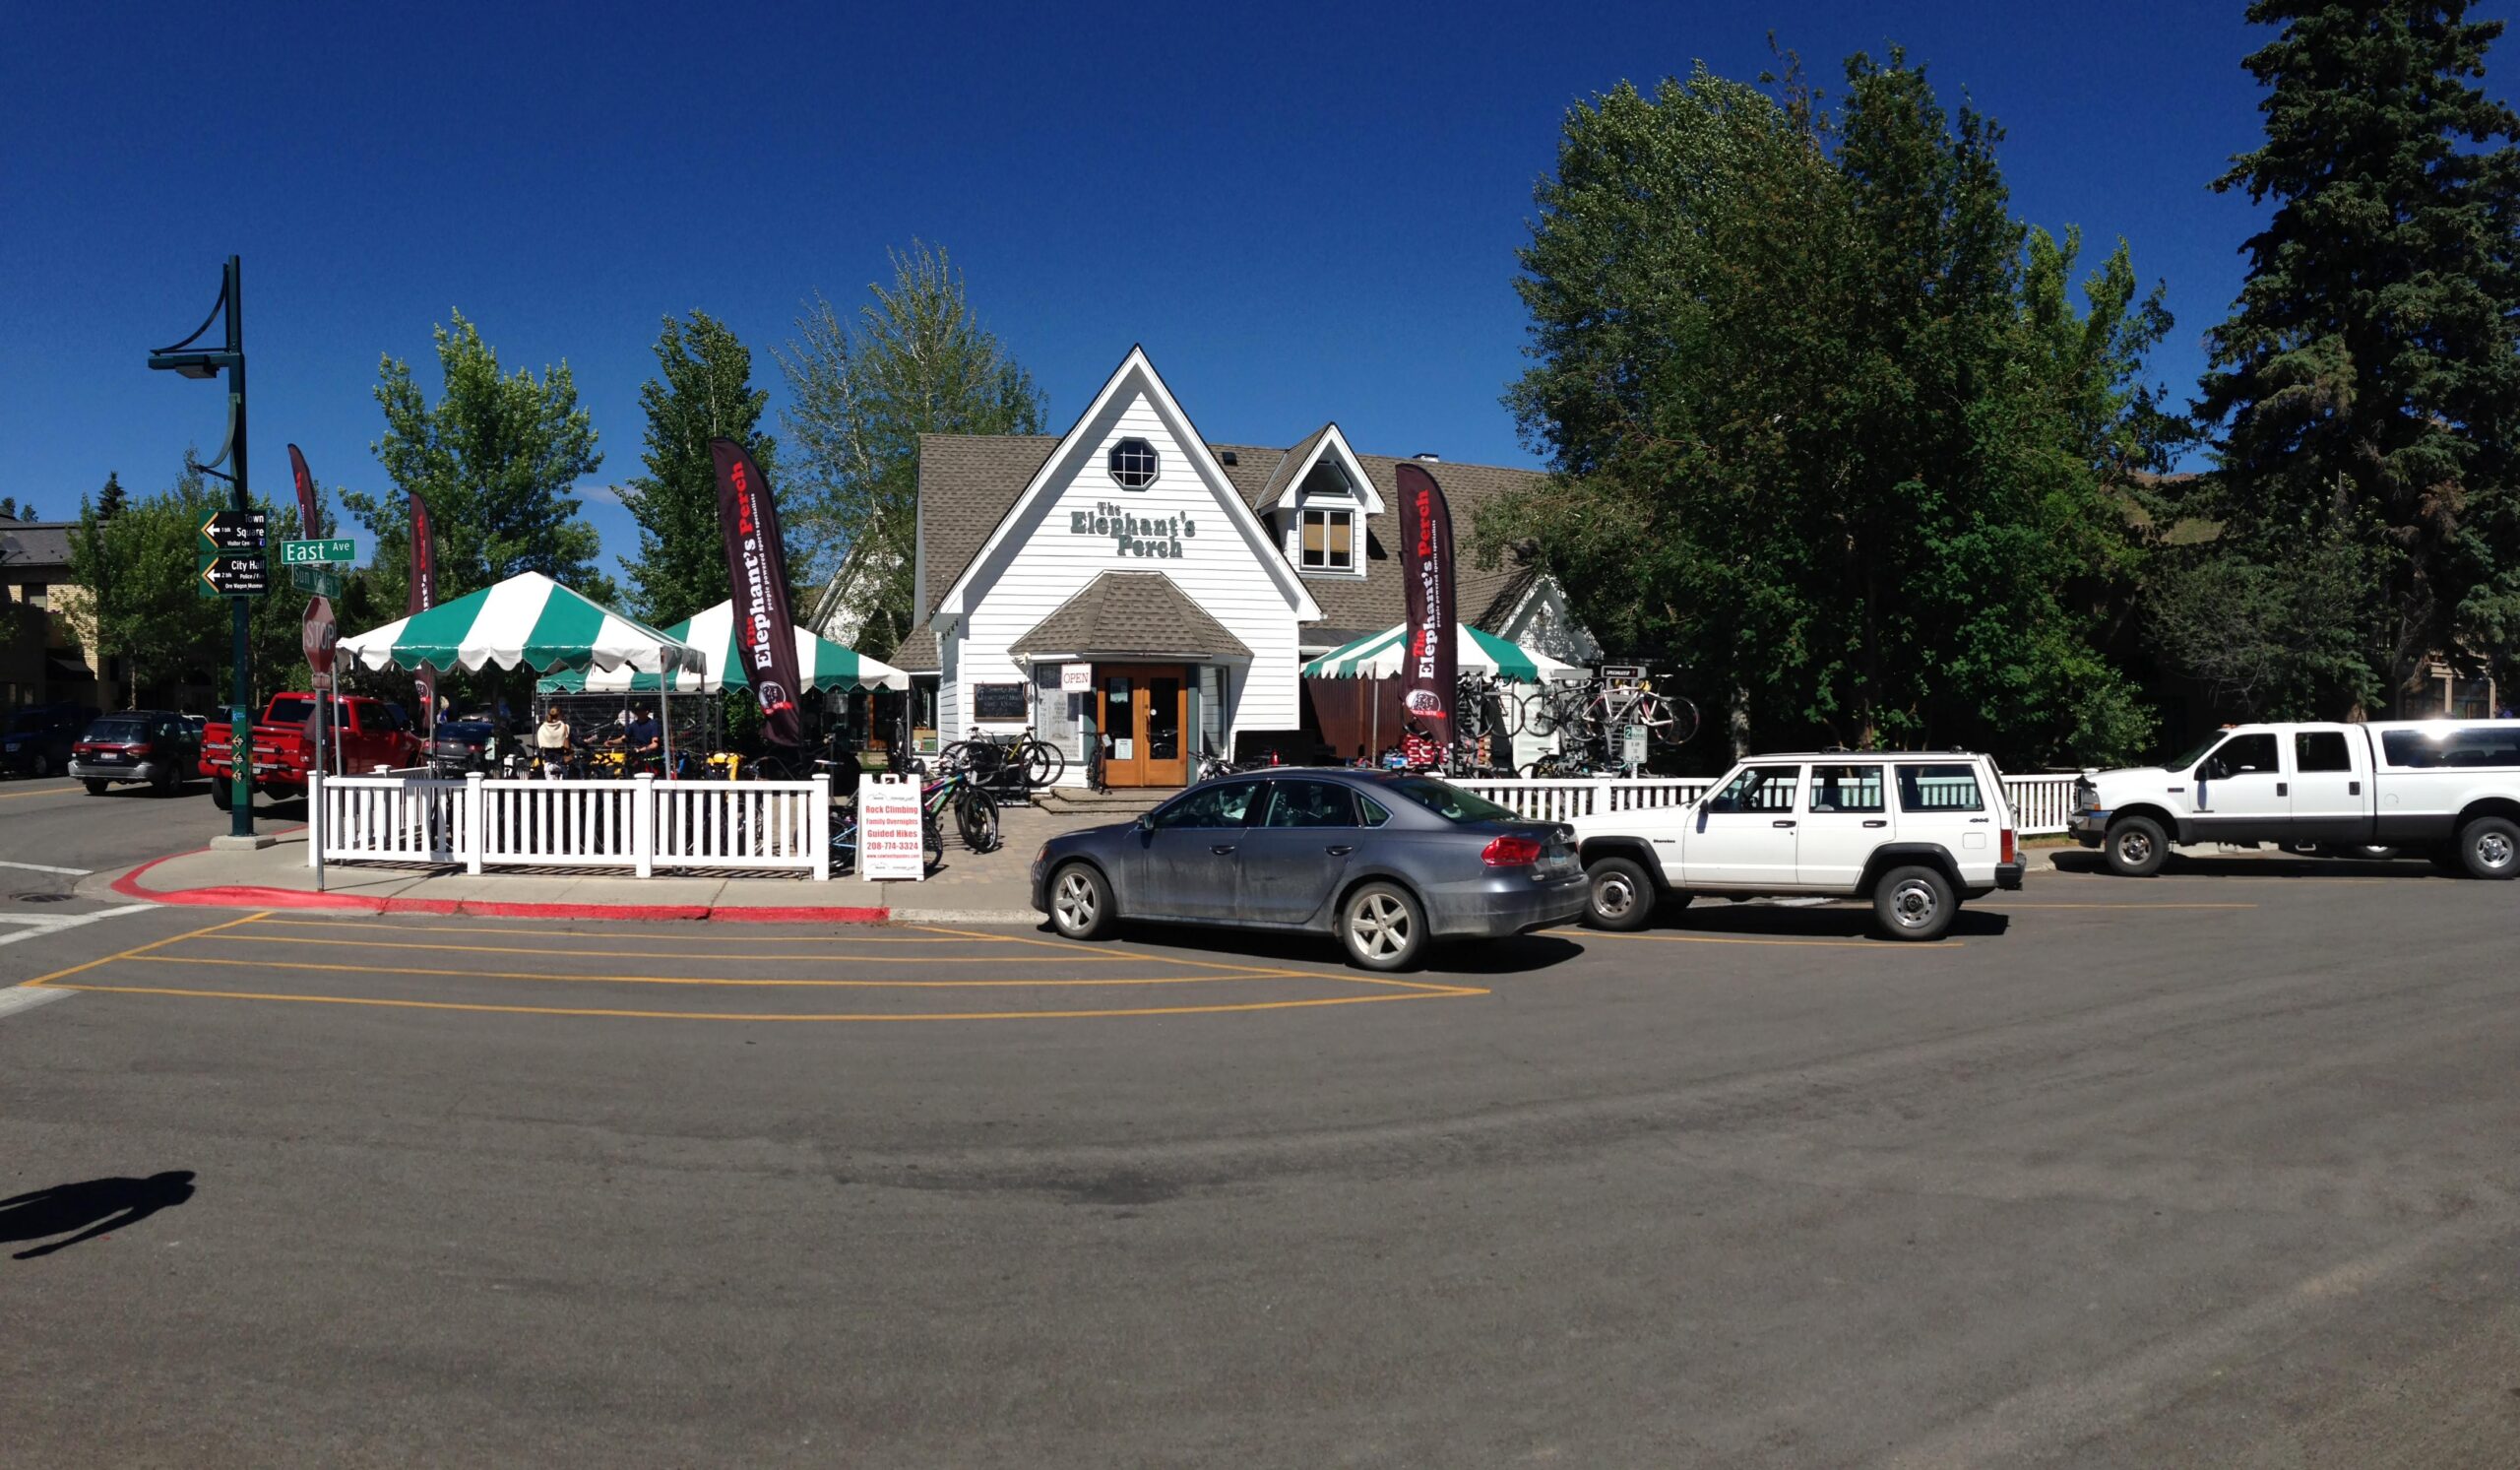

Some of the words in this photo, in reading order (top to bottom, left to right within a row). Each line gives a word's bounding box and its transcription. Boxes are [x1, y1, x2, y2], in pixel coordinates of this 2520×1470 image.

[730, 461, 754, 536] Perch
[1097, 502, 1121, 516] The
[245, 514, 264, 523] Town
[750, 493, 761, 529] specialists
[1416, 489, 1431, 557] Perch
[236, 527, 264, 539] Square
[1070, 510, 1196, 539] Elephant's
[287, 543, 325, 561] East
[333, 543, 350, 551] Ave
[756, 530, 765, 551] sports
[1117, 534, 1183, 559] Perch
[231, 560, 247, 571] City
[250, 560, 264, 570] Hall
[295, 567, 309, 584] Sun
[758, 552, 770, 585] powered
[742, 539, 772, 671] Elephant's
[765, 586, 774, 610] people
[745, 616, 757, 647] The
[1418, 561, 1438, 679] Elephant's
[306, 620, 335, 650] STOP
[1412, 630, 1425, 658] The
[1063, 672, 1089, 683] OPEN
[1626, 729, 1631, 737] 2
[886, 805, 917, 814] Climbing
